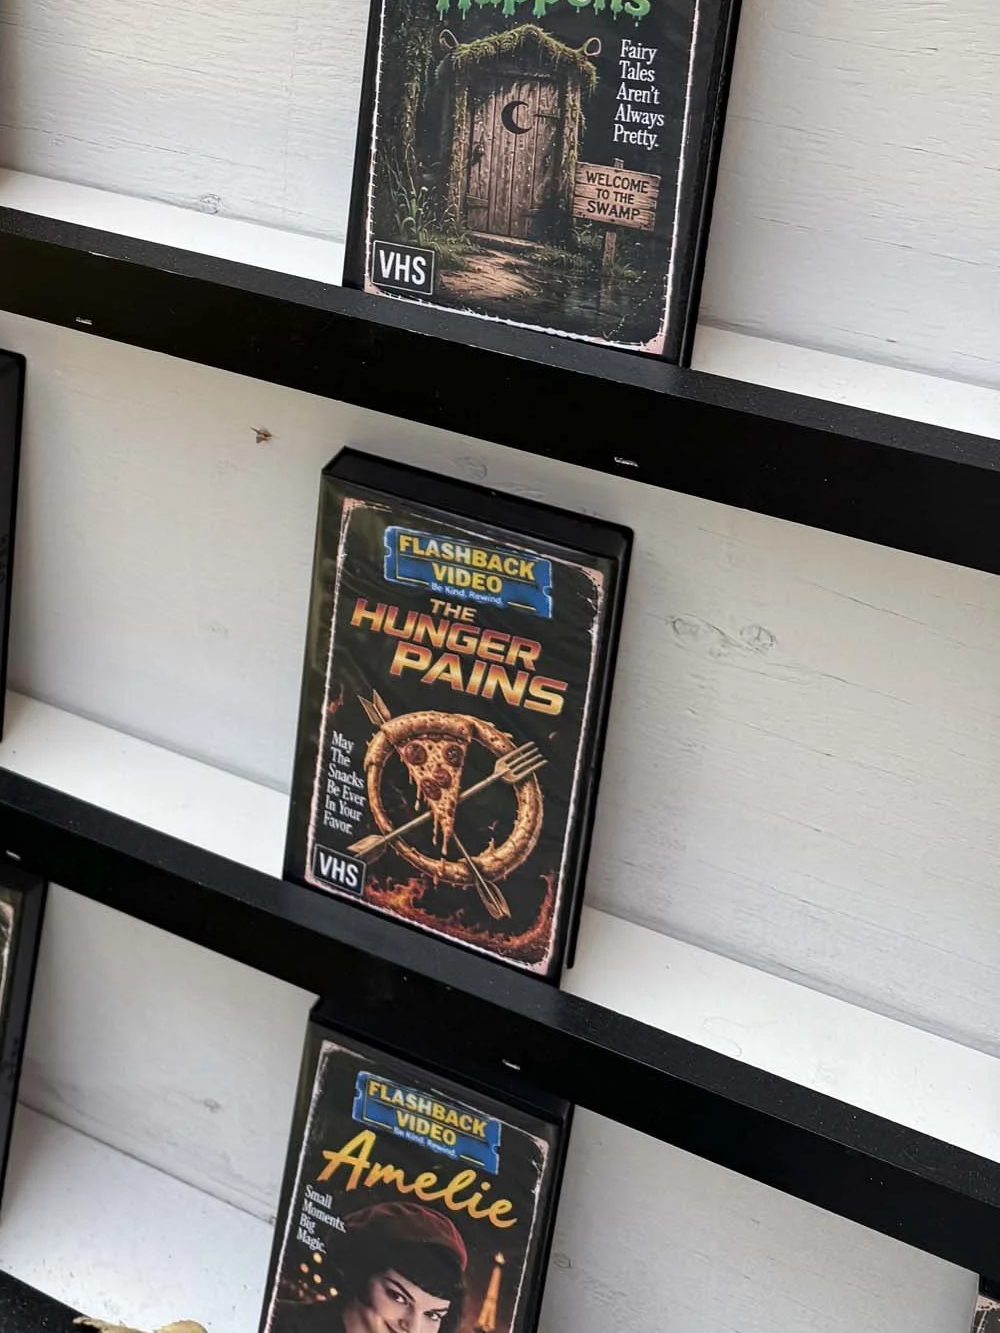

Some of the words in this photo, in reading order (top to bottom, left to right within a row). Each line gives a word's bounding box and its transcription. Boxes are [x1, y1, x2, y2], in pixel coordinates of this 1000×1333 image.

[620, 39, 658, 63] Fairy
[619, 62, 655, 82] Tales
[616, 85, 660, 104] Aren't
[614, 104, 665, 127] Always
[613, 125, 659, 149] Pretty.
[586, 171, 649, 194] WELCOME
[596, 187, 610, 201] TO
[613, 191, 634, 204] THE
[587, 200, 640, 221] SWAMP
[379, 249, 426, 285] VHS
[399, 535, 536, 581] FLASHBACK
[432, 562, 502, 593] VIDEO
[430, 598, 477, 623] THE
[350, 597, 542, 671] HUNGER
[389, 641, 568, 716] PAINS
[331, 731, 354, 753] May
[330, 747, 351, 766] The
[328, 764, 364, 788] Snacks
[326, 779, 342, 795] Be
[342, 785, 367, 808] Ever
[325, 797, 337, 812] In
[338, 801, 362, 822] Your
[323, 813, 353, 835] Favor.
[319, 852, 359, 887] VHS
[368, 1080, 488, 1138] FLASHBACK
[395, 1110, 457, 1146] VIDEO
[316, 1129, 518, 1228] Amelie
[304, 1184, 333, 1210] Small
[300, 1214, 316, 1234] Big
[302, 1200, 347, 1233] Moments.
[296, 1228, 327, 1253] Magic.
